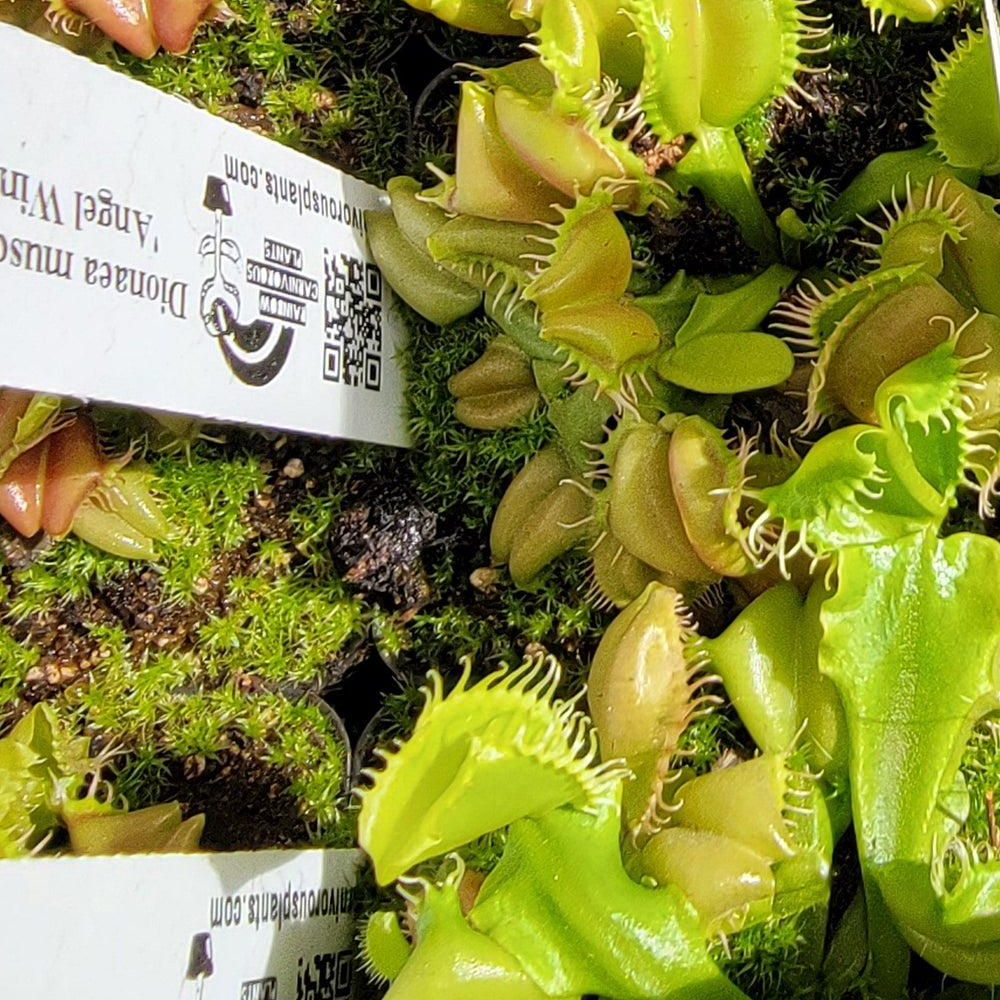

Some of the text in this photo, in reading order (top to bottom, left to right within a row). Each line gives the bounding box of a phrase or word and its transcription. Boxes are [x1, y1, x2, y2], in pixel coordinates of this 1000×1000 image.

[74, 187, 159, 254] 'Angel
[225, 153, 366, 237] ivorousplants.com
[84, 256, 189, 320] Dionaea
